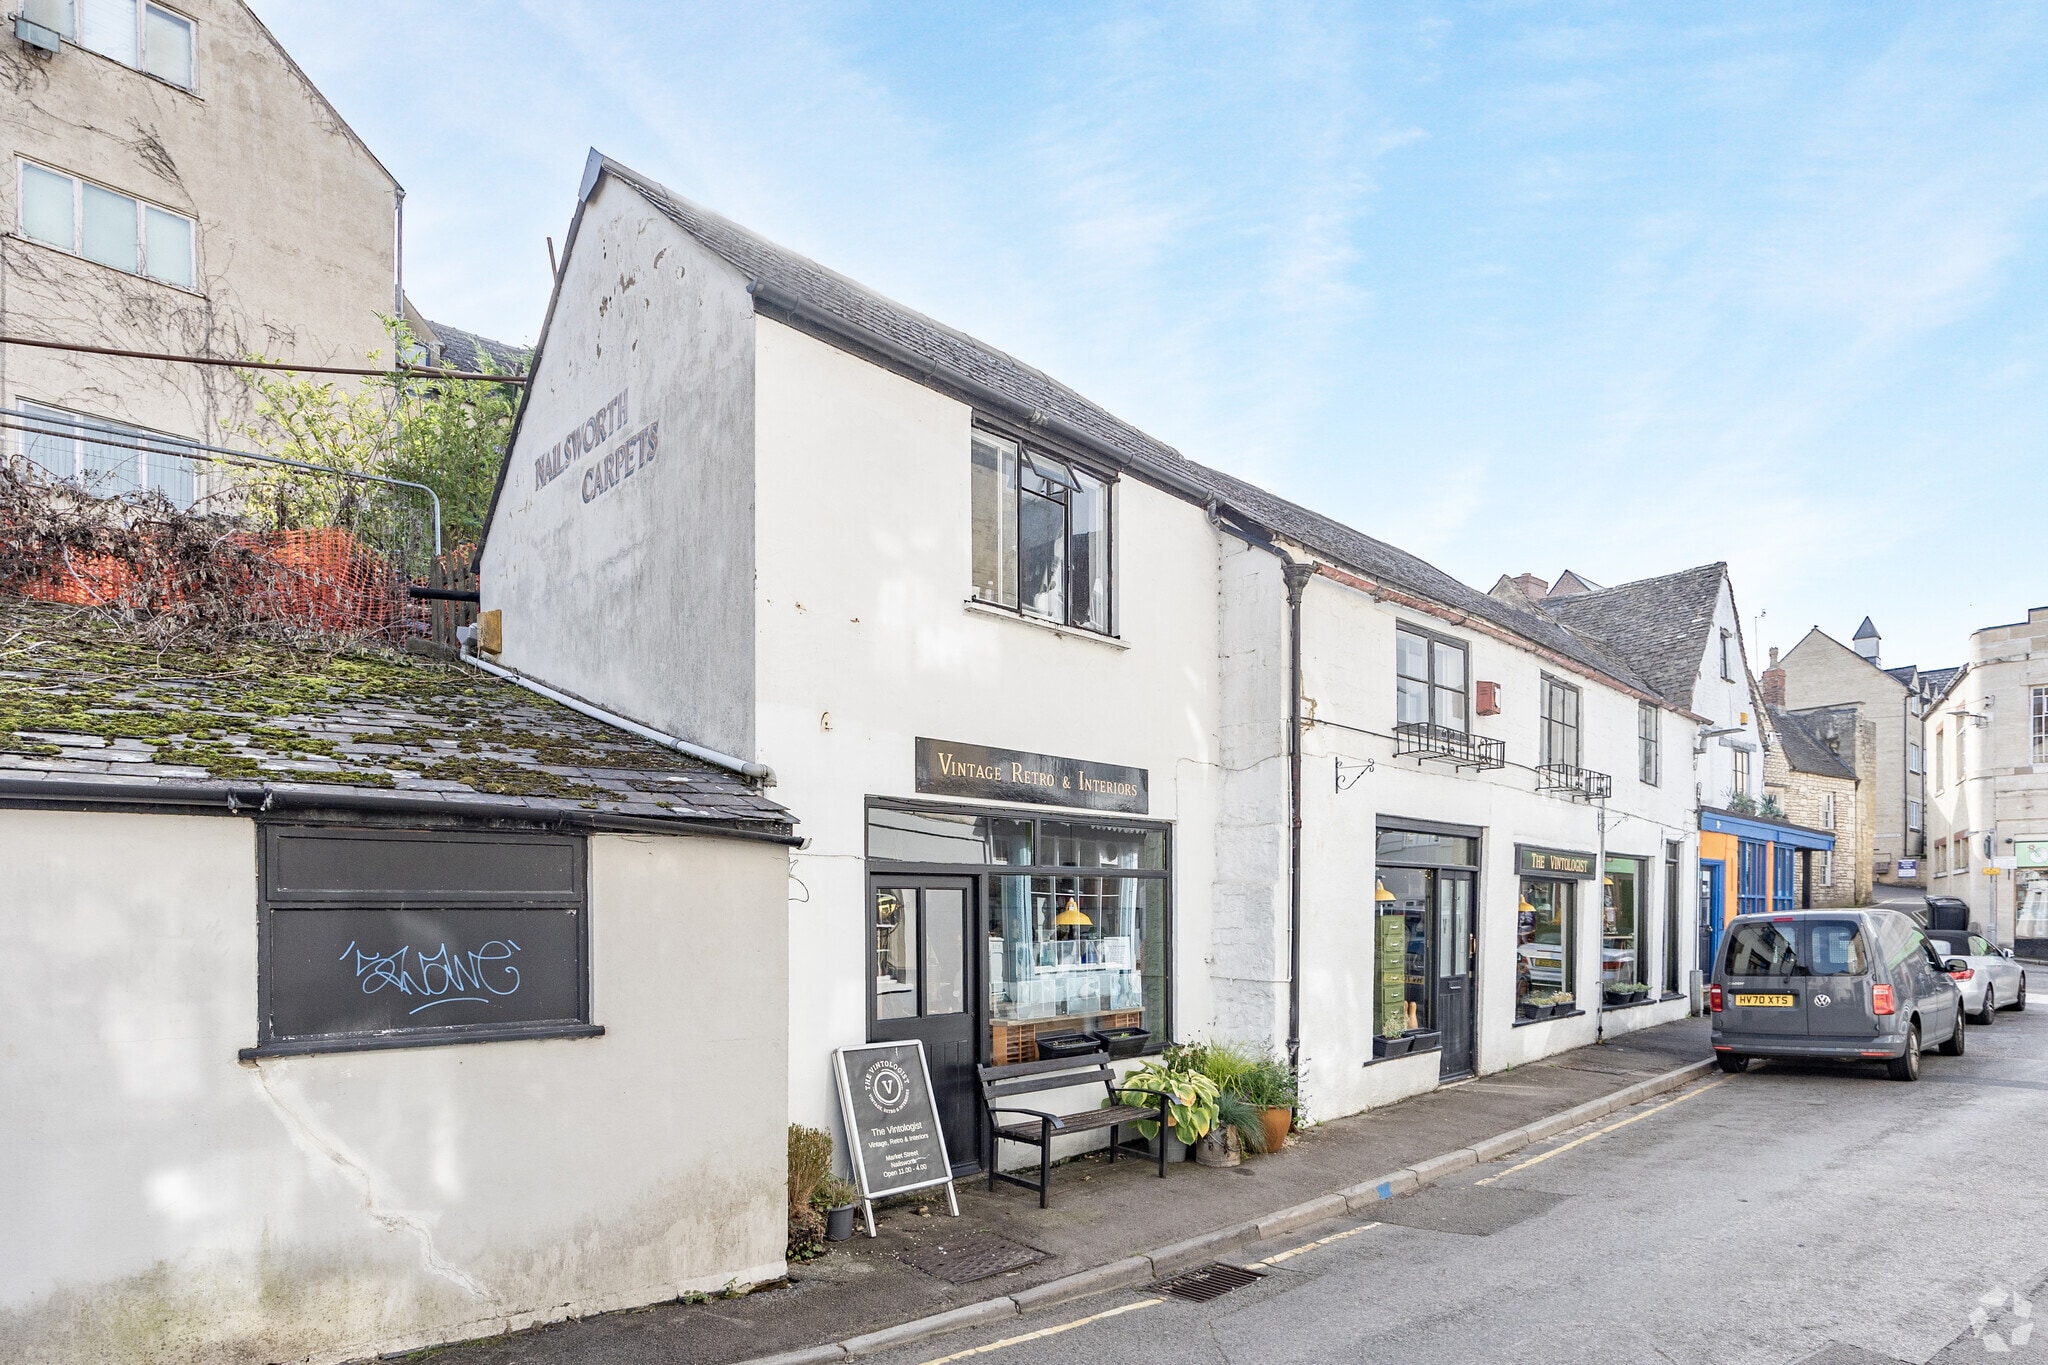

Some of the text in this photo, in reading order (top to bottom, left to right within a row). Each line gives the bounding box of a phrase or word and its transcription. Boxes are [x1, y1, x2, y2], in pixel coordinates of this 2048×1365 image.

[534, 387, 629, 492] NAILSWORTH
[581, 418, 660, 504] CARPETS
[937, 752, 1138, 797] VINTAGE RETRO & INTERIORS
[1531, 852, 1588, 873] THE VINTOLOGIST
[1739, 995, 1788, 1005] HV70 XTS
[869, 1060, 910, 1084] VINTOLOGIST
[871, 1121, 923, 1137] The Vintologist
[909, 1133, 929, 1141] Interiors
[885, 1150, 919, 1161] Market Street
[882, 1170, 898, 1179] Open
[898, 1166, 912, 1175] 11.00
[915, 1163, 928, 1171] 4.00
